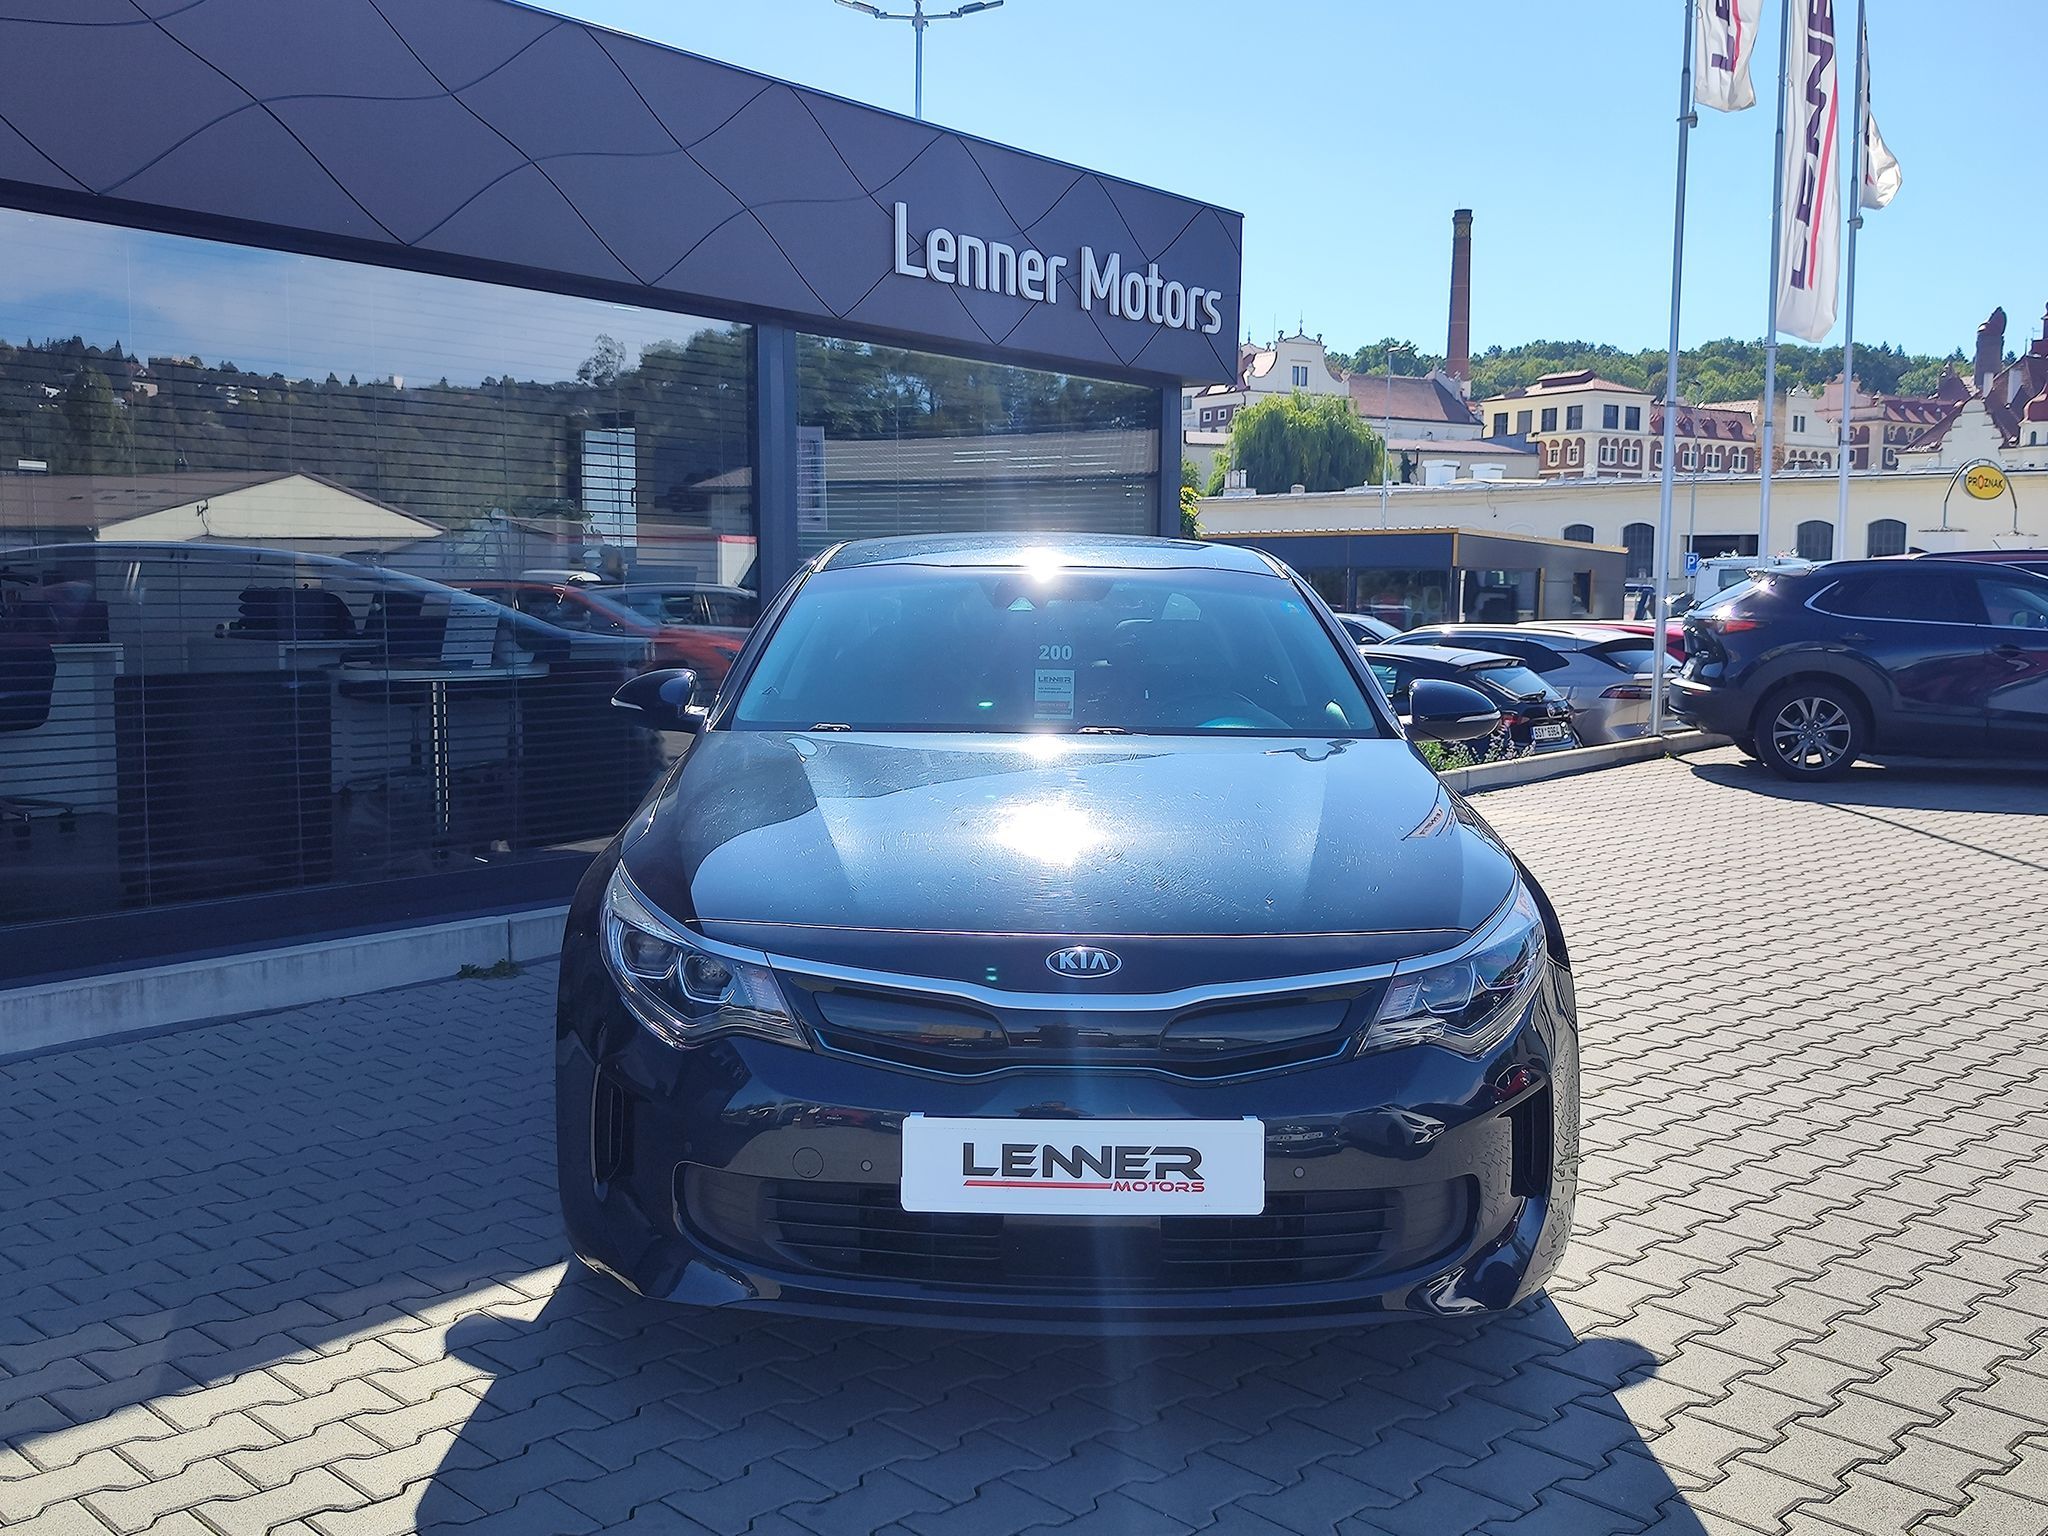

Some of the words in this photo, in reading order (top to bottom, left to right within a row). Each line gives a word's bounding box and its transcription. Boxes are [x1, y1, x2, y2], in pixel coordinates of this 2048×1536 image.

[894, 201, 1067, 304] Lenner
[1080, 245, 1222, 335] Motors
[1038, 644, 1073, 660] 200
[1058, 951, 1110, 970] KIA
[962, 1142, 1205, 1181] LENNER
[1112, 1180, 1205, 1193] MOTORS
